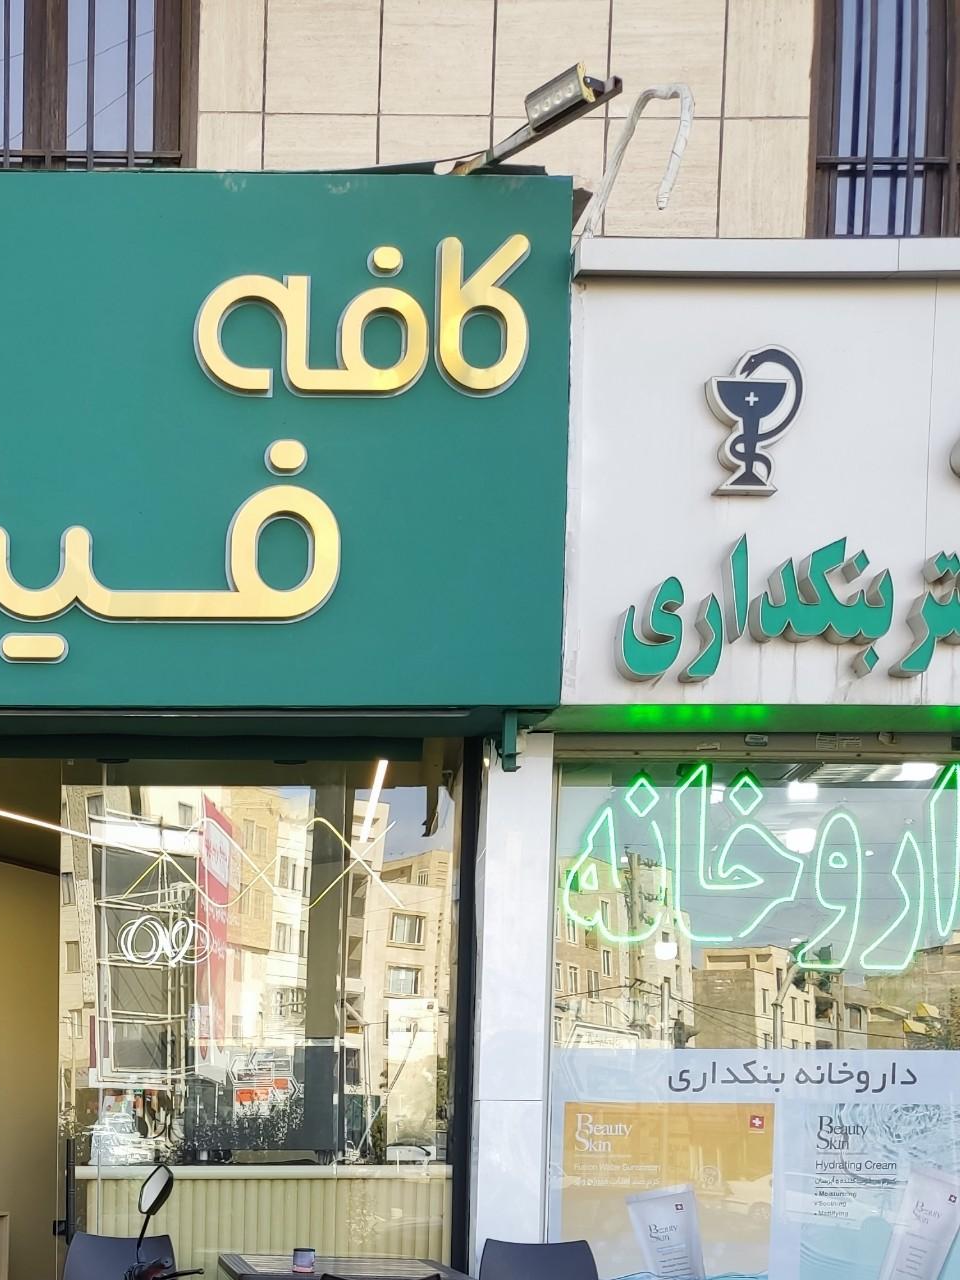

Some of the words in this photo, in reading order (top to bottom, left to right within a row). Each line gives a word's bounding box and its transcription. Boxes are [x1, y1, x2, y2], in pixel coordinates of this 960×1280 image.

[194, 233, 531, 399] کافه
[617, 533, 895, 681] بنکداری
[563, 763, 960, 970] اروخانه
[668, 1060, 785, 1093] بنکداری
[795, 1061, 918, 1093] داروخانه
[576, 1113, 632, 1138] Beauty
[818, 1115, 868, 1138] Beauty
[575, 1130, 612, 1152] Skin
[816, 1130, 849, 1150] Skin
[815, 1160, 862, 1171] Hydrating
[864, 1160, 897, 1170] Cream
